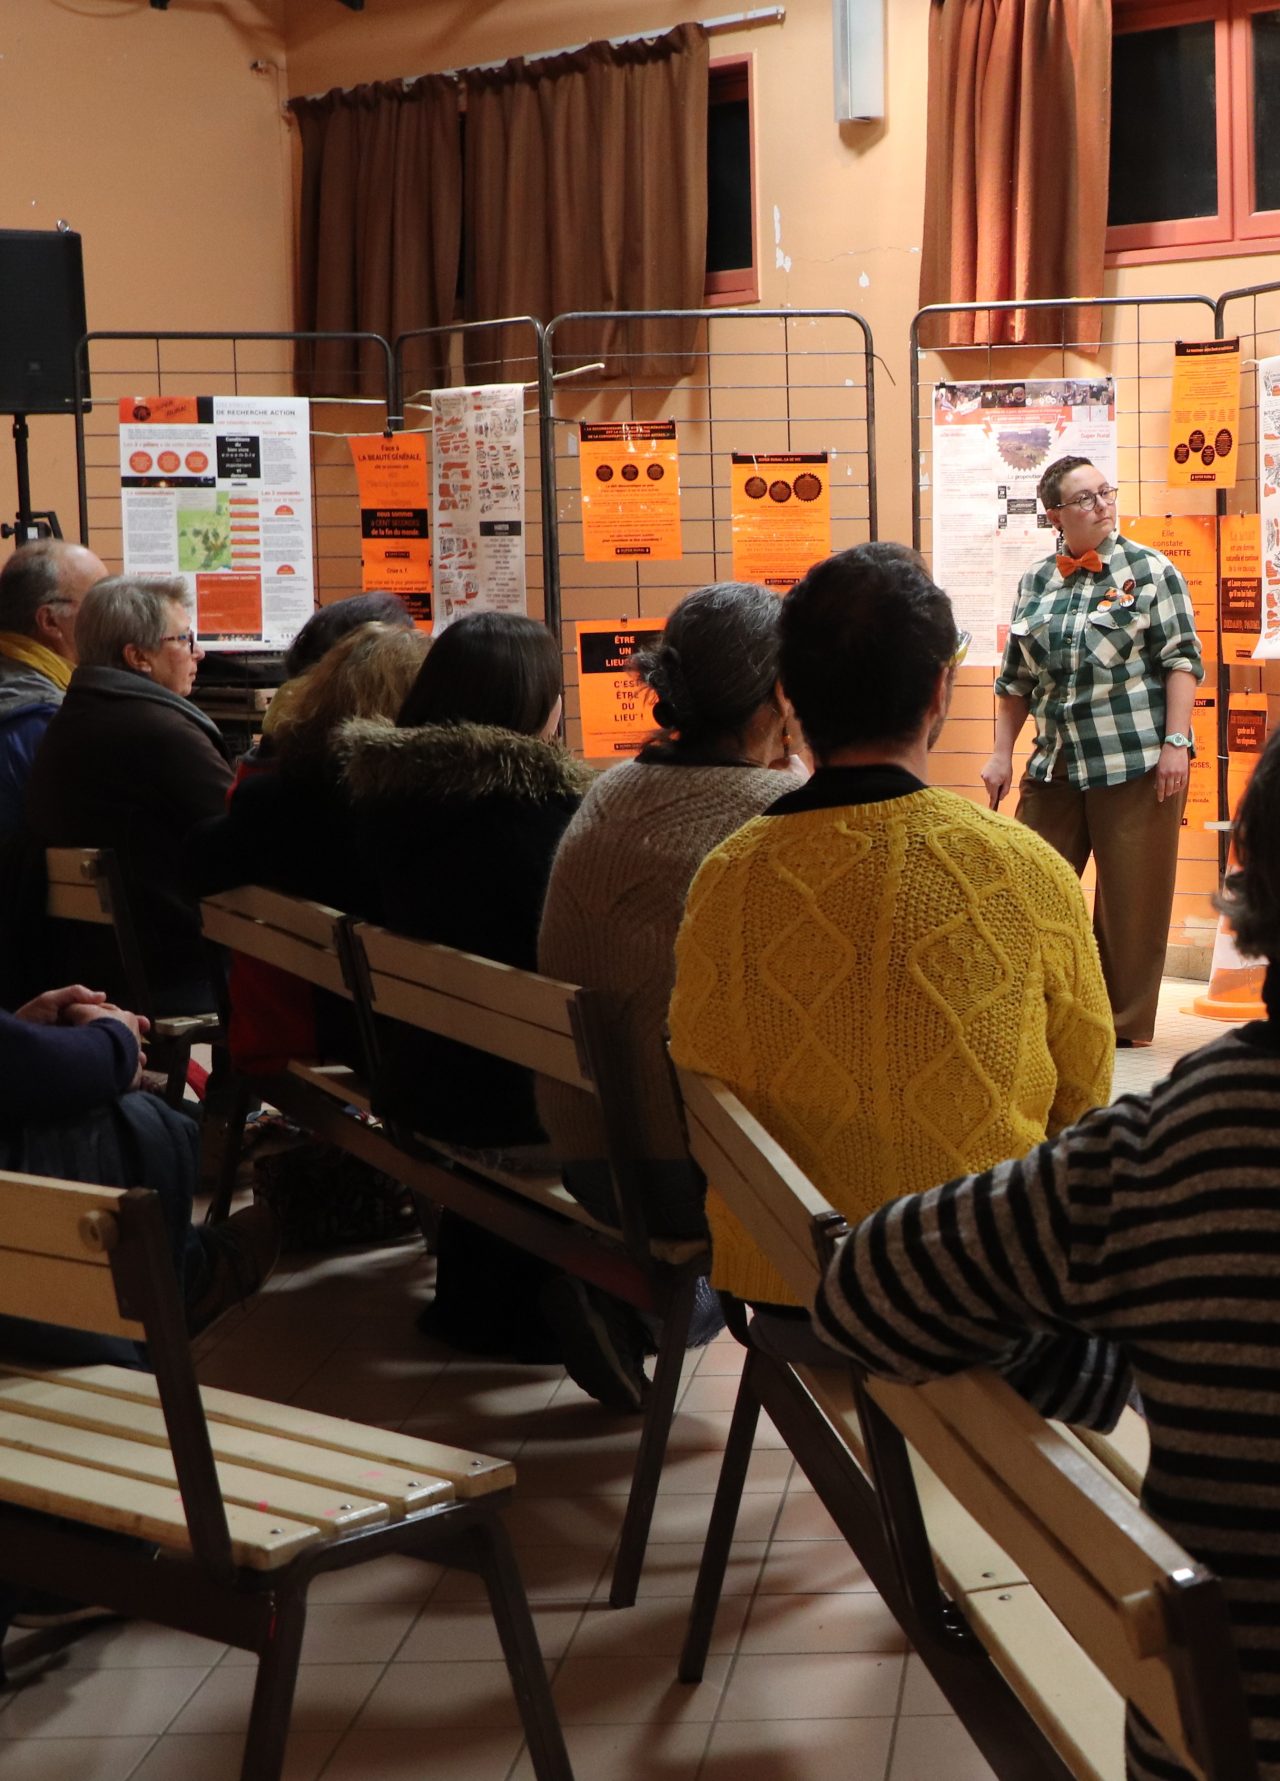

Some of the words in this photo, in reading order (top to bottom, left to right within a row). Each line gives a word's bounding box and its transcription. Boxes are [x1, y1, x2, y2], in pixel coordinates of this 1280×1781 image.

[381, 444, 394, 452] Face
[367, 453, 390, 461] BEAUTÉ
[371, 528, 378, 536] de
[385, 528, 393, 536] fin
[1161, 529, 1175, 537] Elle
[614, 635, 635, 644] ÊTRE
[619, 647, 632, 655] UN
[621, 702, 635, 710] DU
